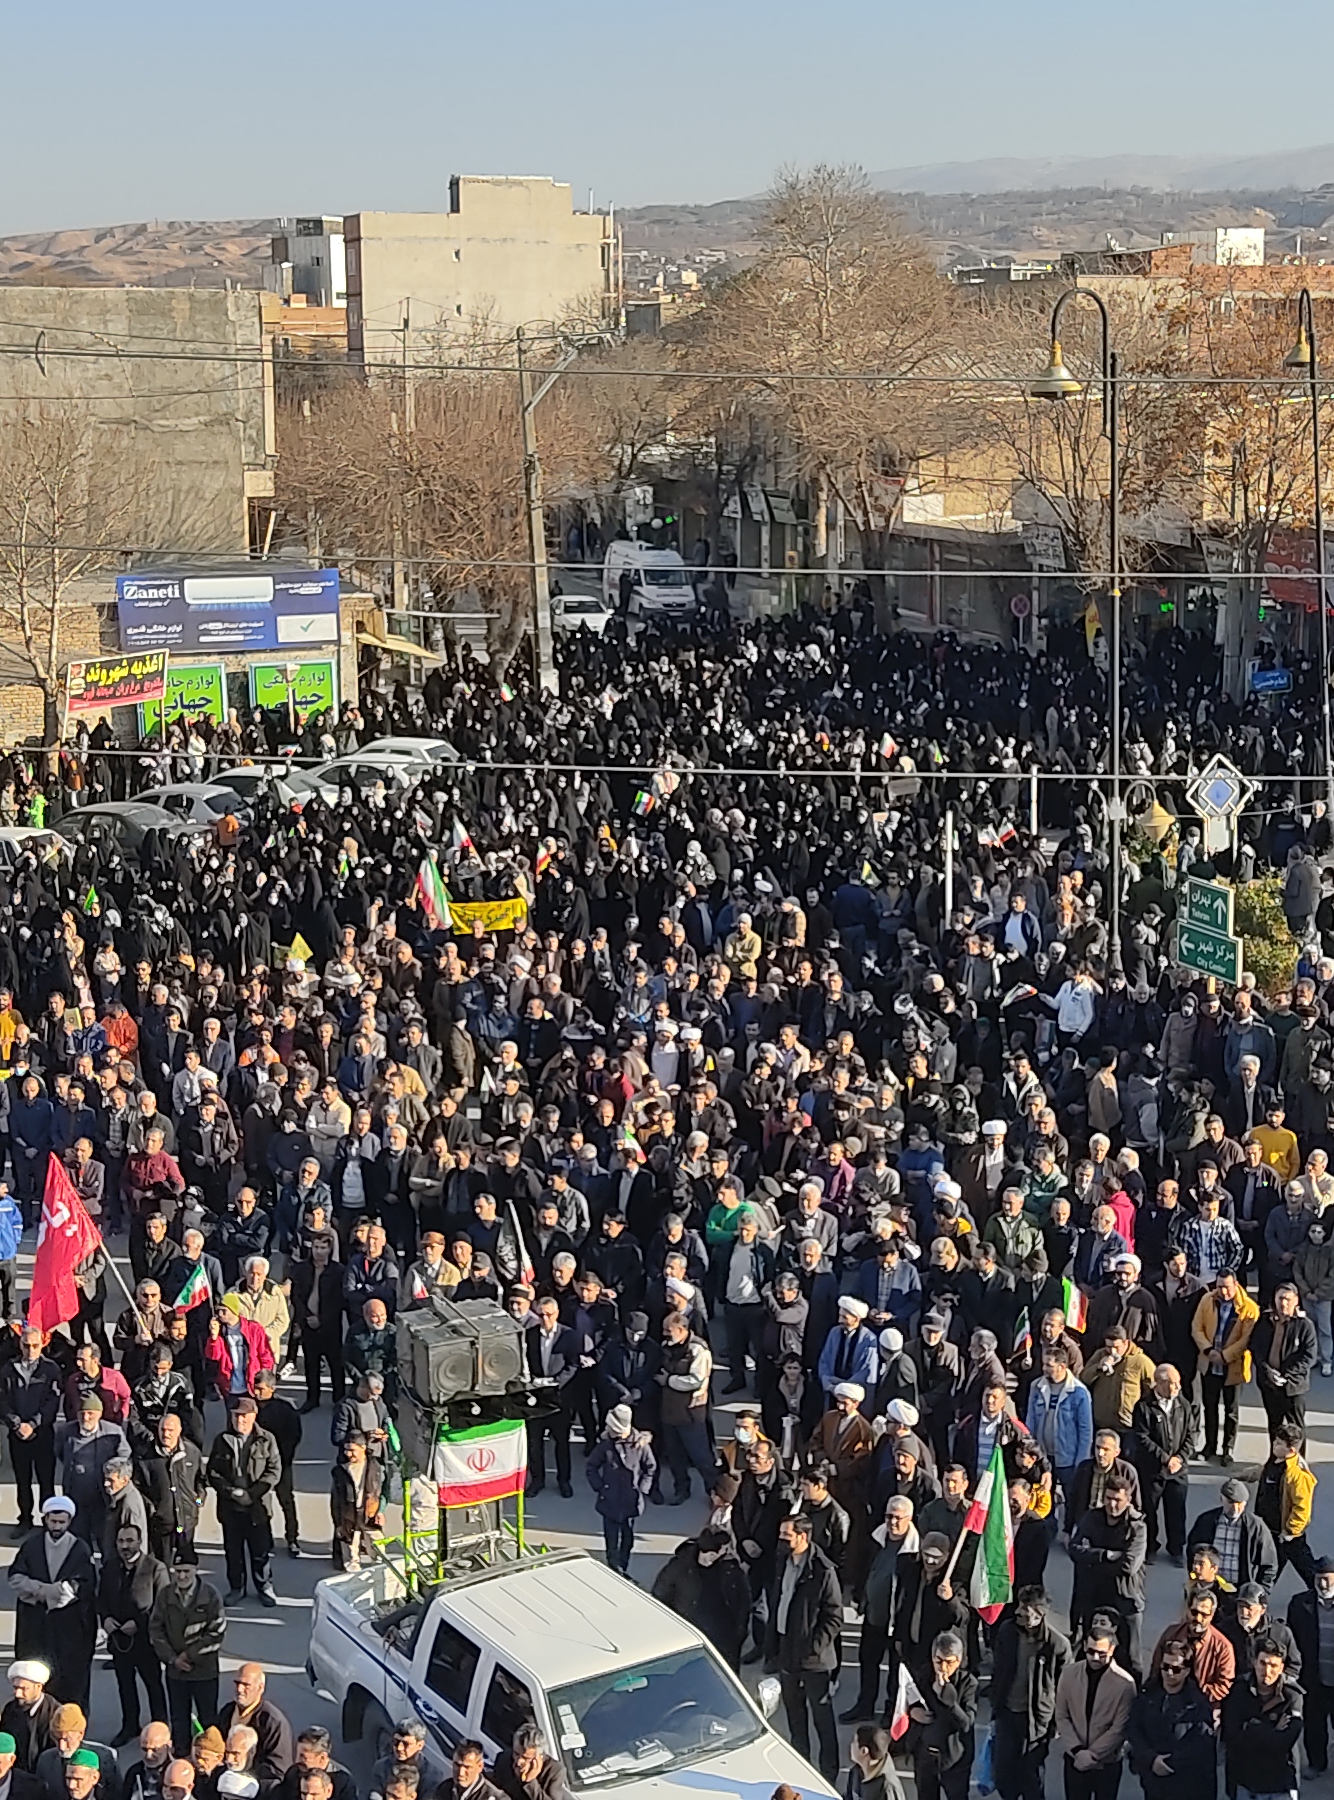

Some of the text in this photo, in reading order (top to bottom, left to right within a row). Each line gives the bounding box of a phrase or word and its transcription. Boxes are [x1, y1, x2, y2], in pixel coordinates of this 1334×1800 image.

[124, 584, 181, 600] Zaneti
[85, 653, 164, 687] اغذیه شهروند
[298, 671, 327, 687] لوازم
[167, 675, 185, 690] خان
[186, 673, 215, 690] لوازم
[152, 689, 214, 719] جهانی
[265, 687, 325, 713] جهای
[1191, 888, 1212, 908] تهران
[1191, 906, 1211, 922] Tehran
[1197, 940, 1235, 962] مرکز شهر
[1196, 955, 1227, 974] City Center
